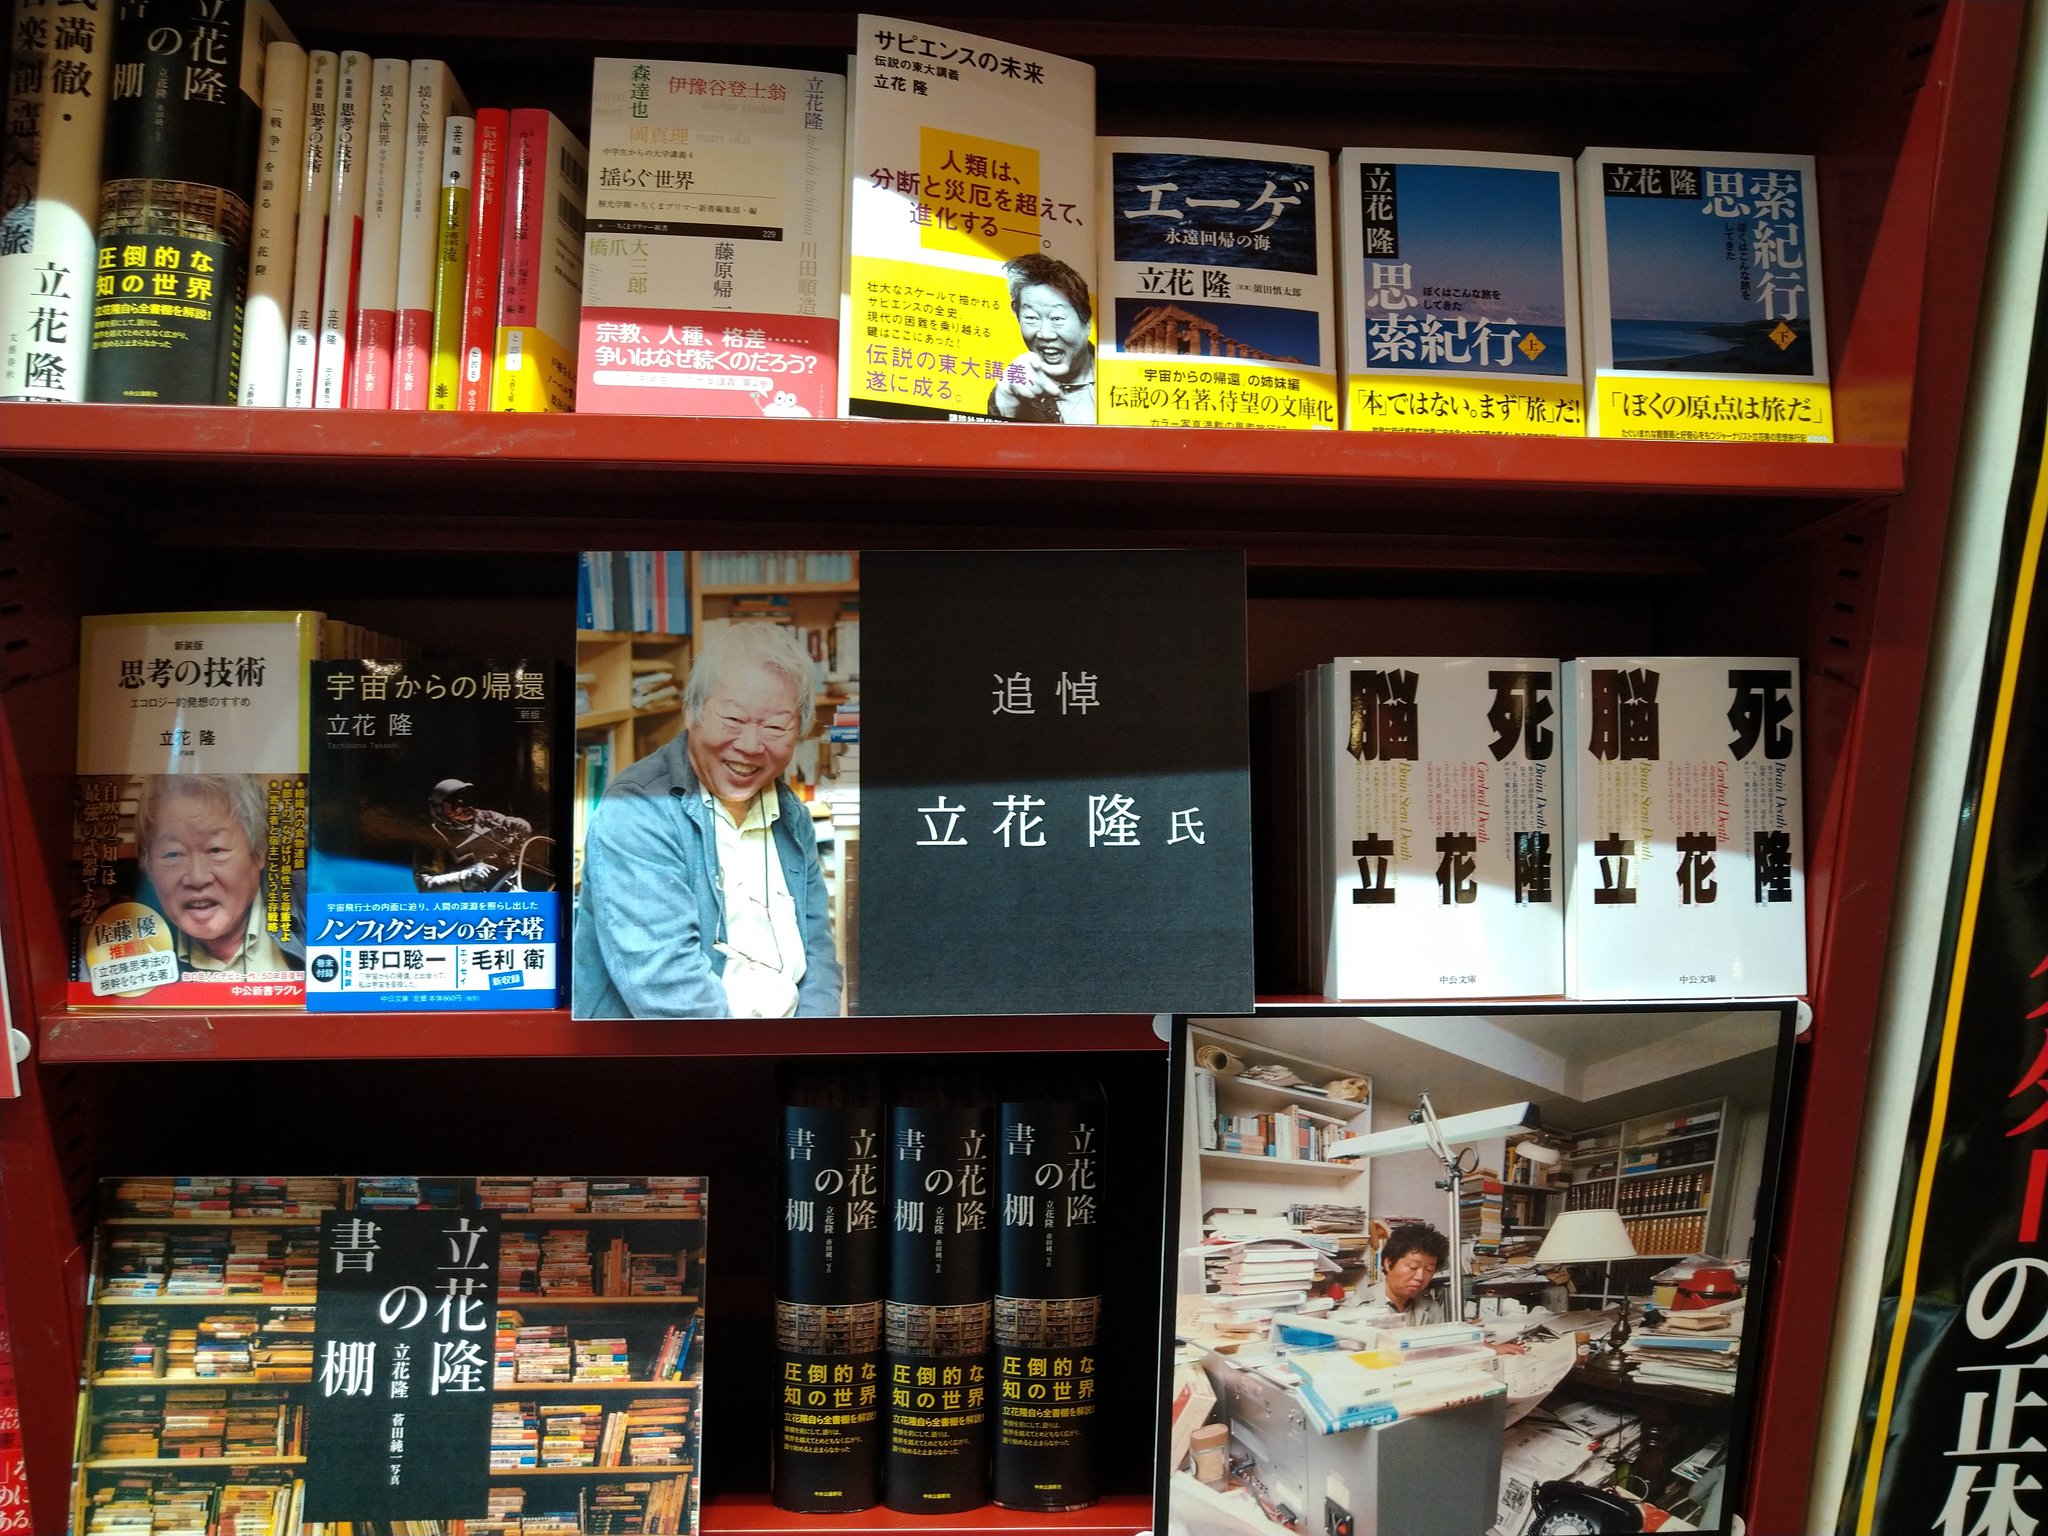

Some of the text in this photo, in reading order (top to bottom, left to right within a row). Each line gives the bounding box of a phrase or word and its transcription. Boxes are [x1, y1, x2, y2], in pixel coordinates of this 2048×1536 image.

[147, 27, 183, 56] の
[874, 29, 1045, 85] サピエンスの未来
[51, 0, 98, 122] 満徹・
[873, 54, 961, 82] 伝説の東大講義
[629, 63, 651, 119] 森達也
[873, 73, 929, 97] 立花 隆
[378, 84, 394, 147] 揺らぐ世界
[416, 84, 432, 147] 揺らぐ世界
[804, 76, 825, 131] 立花隆
[629, 126, 690, 146] 岡真理
[599, 167, 695, 191] 揺らぐ世界
[939, 149, 1022, 186] 人類は、
[1607, 166, 1699, 197] 立花 隆
[869, 167, 1084, 227] 分断と災厄を超えて、
[1123, 179, 1311, 234] エーゲ
[1364, 167, 1396, 255] 立花 隆
[1701, 170, 1751, 219] 思
[762, 230, 777, 239] 229
[1163, 227, 1273, 253] 永遠回帰の海
[1749, 172, 1807, 322] 索紀行
[255, 227, 271, 276] 立花隆
[95, 273, 213, 301] 知の世界
[713, 242, 735, 309] 藤原帰一
[1135, 265, 1195, 298] 立花
[1202, 269, 1232, 300] 隆
[1367, 262, 1419, 310] 思
[1422, 286, 1502, 300] ぼくはこんな旅を
[1422, 300, 1463, 312] してきた
[25, 261, 72, 391] 立花隆
[1368, 312, 1540, 367] 索紀行 上
[1778, 330, 1790, 345] 下
[595, 348, 818, 375] 争いはなぜ続くのだろう?
[865, 342, 1039, 387] 伝説の東大講義、
[1108, 384, 1335, 423] 伝説の名著、待望の文庫化
[1357, 388, 1581, 424] 「本」ではない。まず「旅」だ!
[1611, 390, 1824, 425] 「ぼくの原点は旅だ」
[174, 640, 204, 651] 新装版
[118, 656, 267, 690] 思考の技術
[326, 672, 546, 701] 宇宙からの帰還
[991, 670, 1101, 716] 追悼
[326, 713, 414, 737] 立花 隆
[519, 709, 541, 720] 新版
[199, 729, 216, 747] 隆
[101, 782, 121, 886] 自然の「知」は
[81, 783, 101, 926] 最強の武器である
[1351, 830, 1553, 906] 立花隆
[1593, 829, 1793, 905] 立花隆
[94, 914, 158, 947] 佐藤 優
[315, 916, 546, 944] ノンフィクションの金字塔
[358, 949, 447, 971] 野口聡一
[471, 949, 545, 970] 毛利 衛
[231, 985, 304, 997] 中公新書ラクレ
[492, 974, 521, 987] 新収録
[1438, 974, 1477, 985] 中公文庫
[1678, 974, 1717, 985] 中公文庫
[814, 1168, 844, 1196] の
[847, 1128, 879, 1234] 立花隆
[924, 1168, 954, 1197] の
[956, 1128, 988, 1234] 立花隆
[1034, 1162, 1064, 1190] の
[1066, 1122, 1097, 1228] 立花隆
[378, 1285, 428, 1330] の
[430, 1217, 490, 1396] 立花隆
[389, 1342, 412, 1400] 立花隆
[784, 1361, 878, 1385] 圧倒的な
[892, 1362, 986, 1386] 圧倒的な
[1002, 1355, 1096, 1379] 圧倒的な
[783, 1386, 878, 1408] 知の世界
[892, 1387, 986, 1410] 知の世界
[1002, 1379, 1096, 1403] 知の世界
